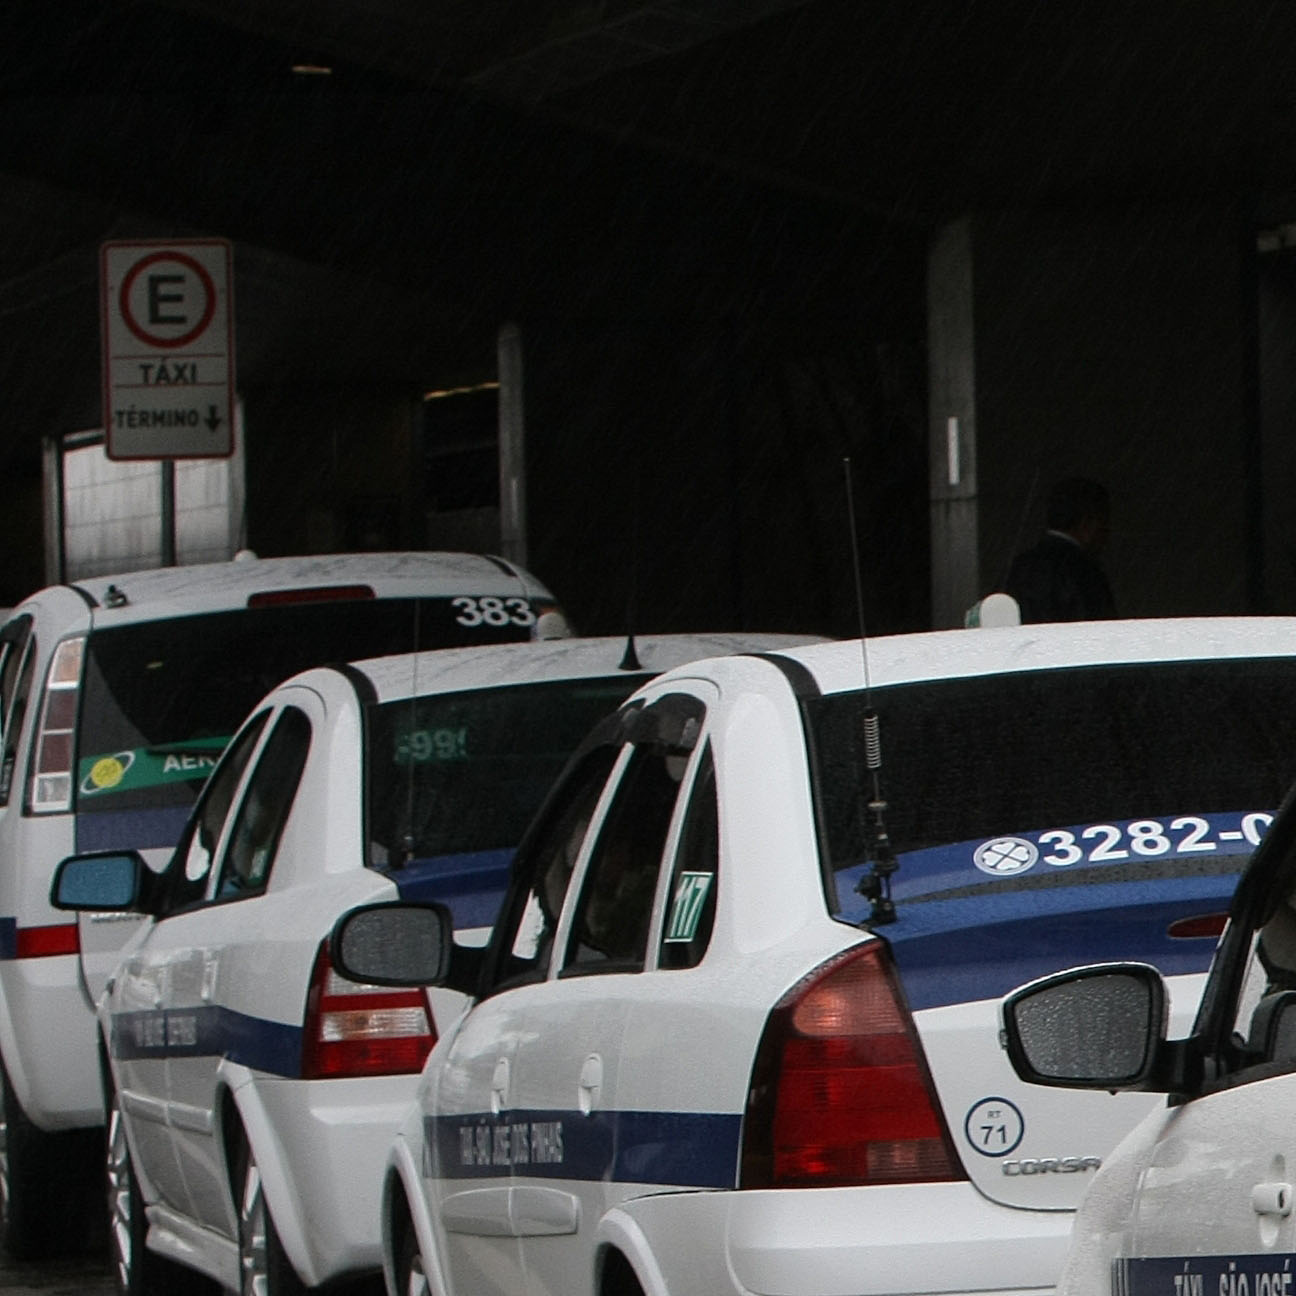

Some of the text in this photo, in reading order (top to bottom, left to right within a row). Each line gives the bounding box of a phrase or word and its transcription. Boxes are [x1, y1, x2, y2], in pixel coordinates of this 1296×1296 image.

[148, 274, 187, 324] E
[139, 357, 198, 385] TÁXI
[116, 405, 200, 428] TÉRMINO
[452, 597, 536, 626] 383
[980, 1124, 1007, 1145] 71
[1002, 1156, 1102, 1177] CORSA
